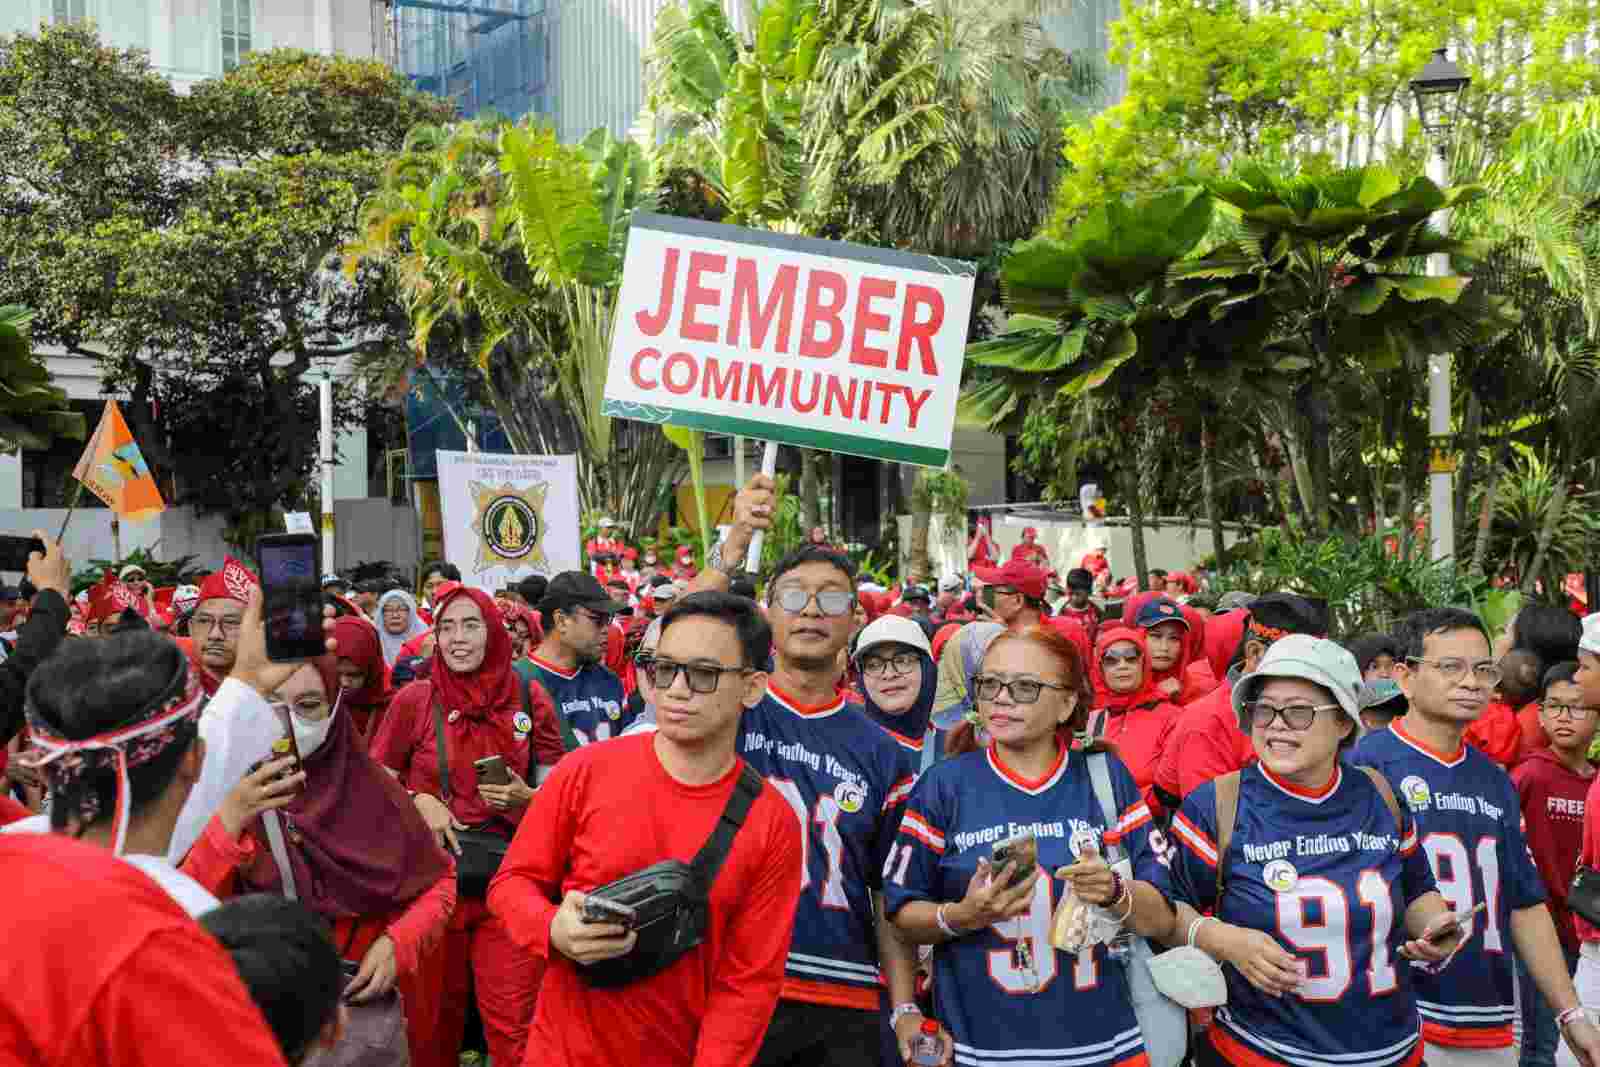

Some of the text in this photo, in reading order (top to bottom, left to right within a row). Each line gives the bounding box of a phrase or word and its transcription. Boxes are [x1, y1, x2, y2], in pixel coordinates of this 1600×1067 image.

[635, 248, 945, 376] JEMBER
[630, 347, 933, 429] COMMUNITY
[954, 822, 1004, 853] Never
[1433, 792, 1476, 815] Ending
[1243, 831, 1399, 863] Never Ending Year's
[1420, 832, 1503, 954] 91
[1274, 869, 1398, 1003] 91
